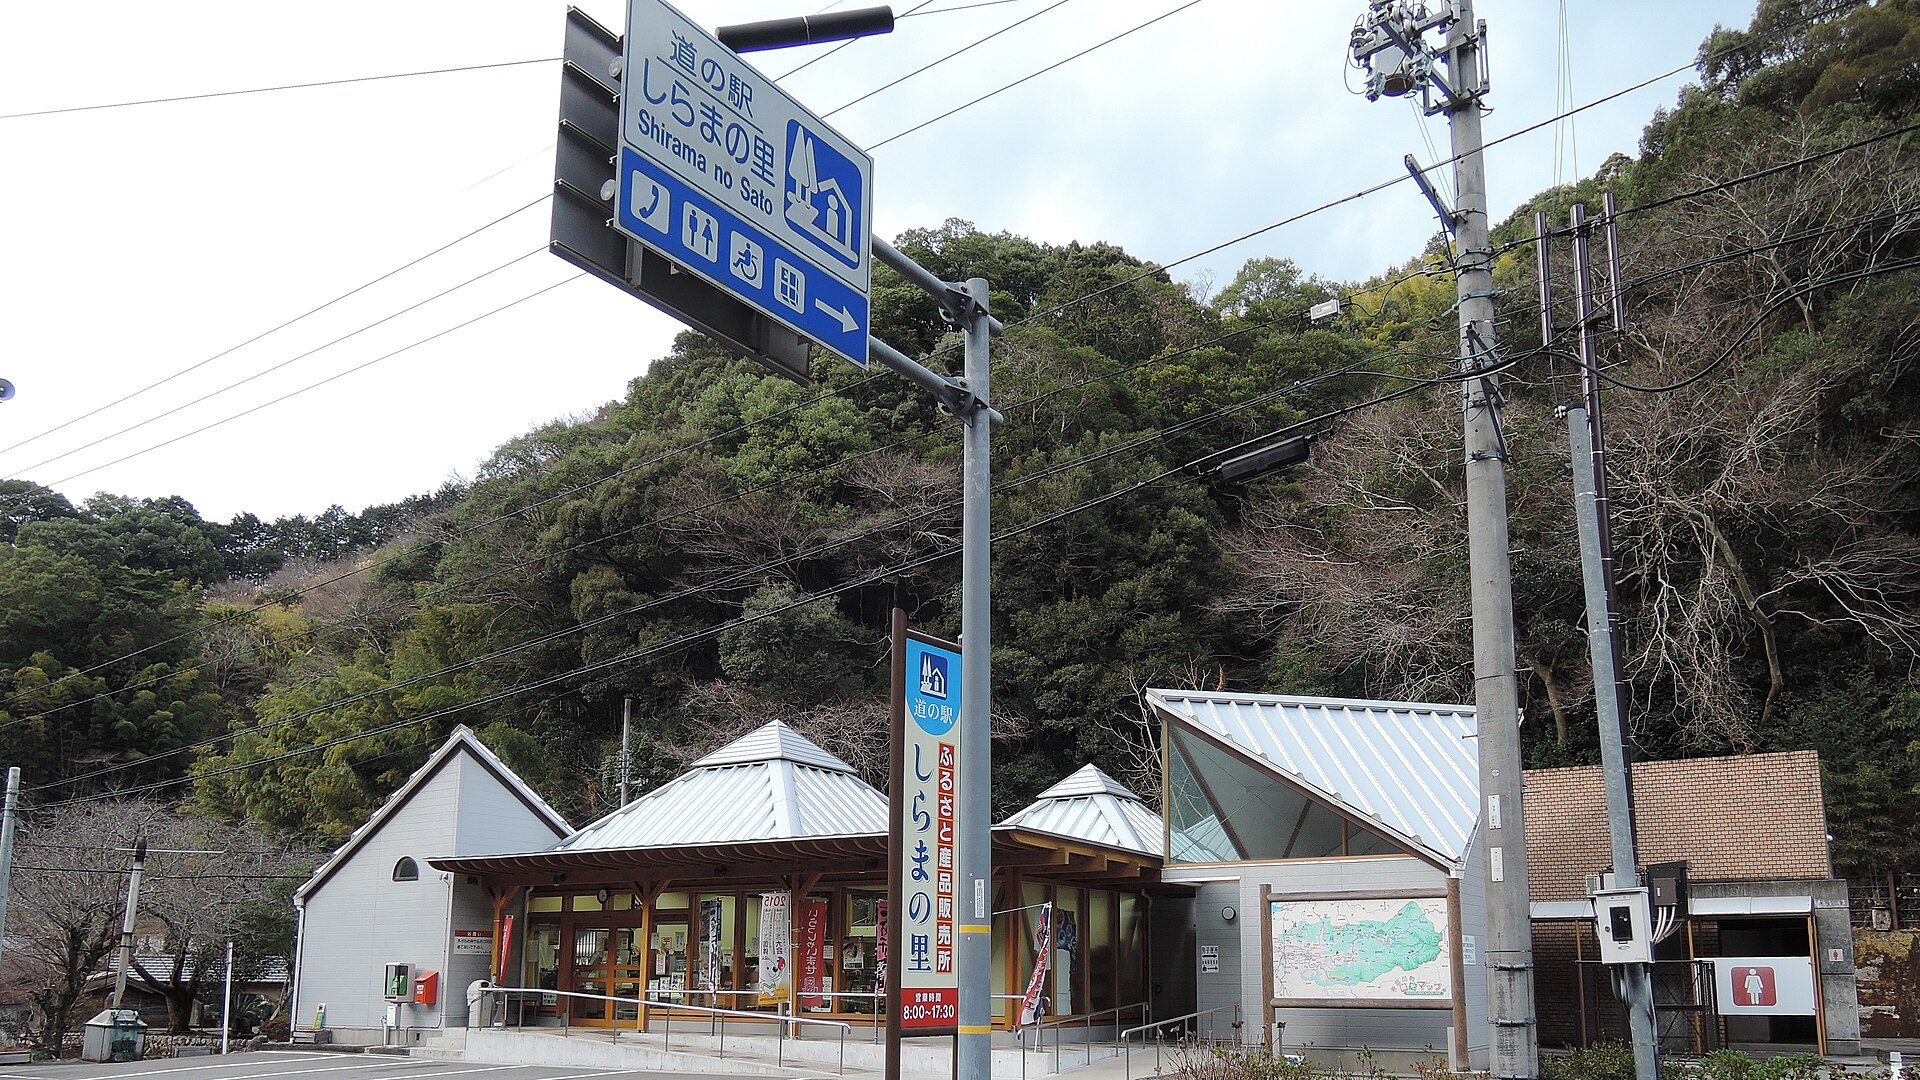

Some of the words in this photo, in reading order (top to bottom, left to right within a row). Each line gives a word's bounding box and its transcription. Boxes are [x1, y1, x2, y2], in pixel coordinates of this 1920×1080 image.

[643, 57, 776, 188] しらまの里
[669, 29, 753, 118] 道の駅
[638, 108, 707, 174] Shirama
[713, 163, 733, 190] no
[739, 176, 773, 216] Sato
[913, 697, 953, 725] 道の駅
[908, 743, 934, 973] しらまの里
[938, 747, 953, 972] ふるさと産品販売所
[903, 1004, 955, 1020] 8:00~17:30
